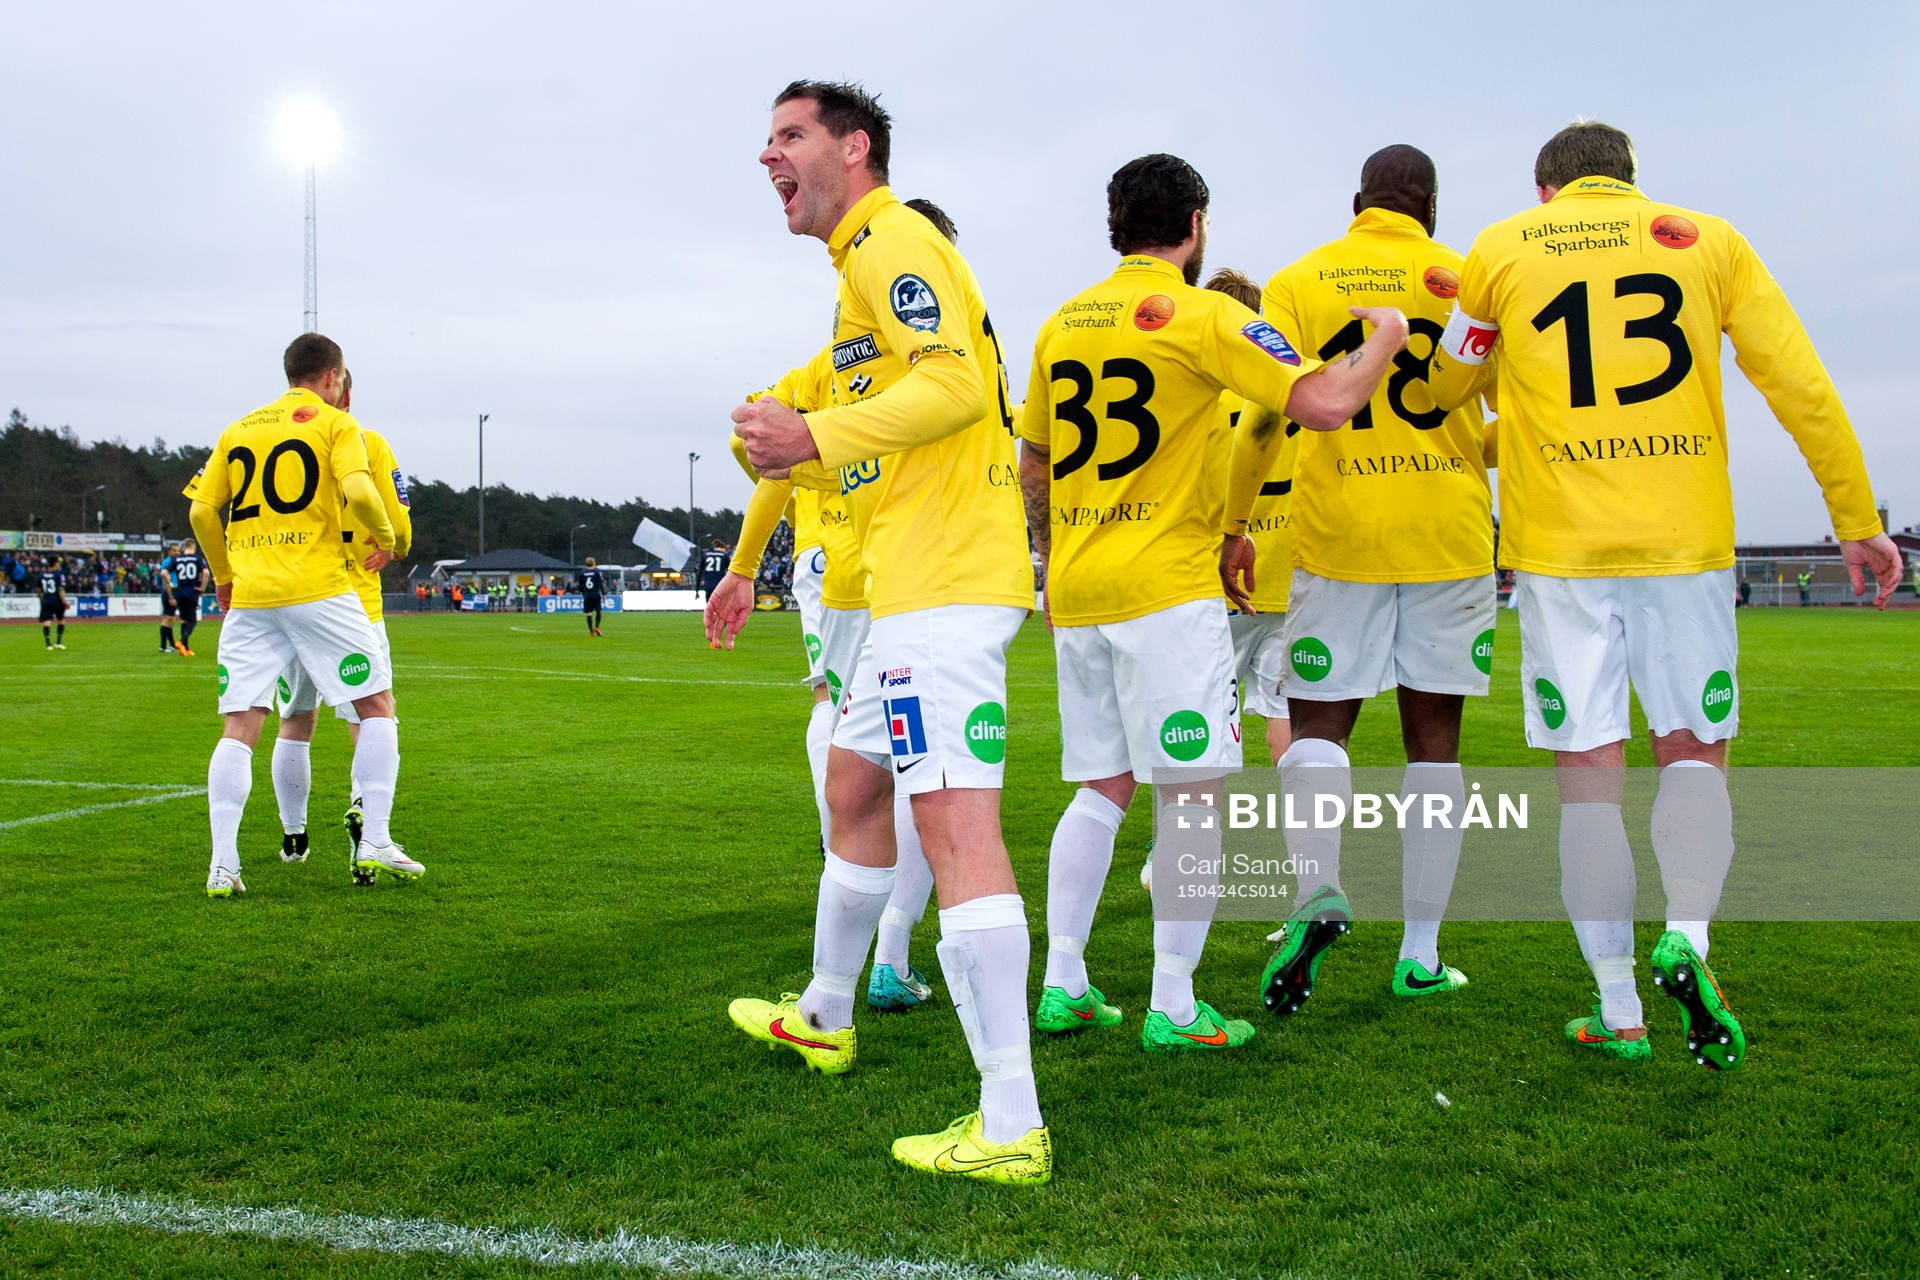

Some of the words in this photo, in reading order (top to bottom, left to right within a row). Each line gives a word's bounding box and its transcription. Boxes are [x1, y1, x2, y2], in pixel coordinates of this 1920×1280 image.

[1522, 220, 1630, 241] Falkenbergs
[1544, 234, 1630, 256] Sparbank
[1319, 266, 1406, 280] Falkenbergs
[1336, 280, 1406, 296] Sparbank
[1058, 300, 1125, 316] Falkenbergs
[1062, 315, 1118, 333] Sparbank
[1531, 273, 1693, 409] 13
[1051, 358, 1160, 481] 33
[1336, 453, 1465, 477] CAMPADRE
[227, 439, 320, 523] 20
[176, 563, 197, 579] 20
[705, 556, 722, 572] 21
[41, 580, 56, 593] 13
[586, 577, 594, 589] 6
[1293, 650, 1328, 666] dina
[341, 661, 369, 677] dina
[888, 668, 911, 678] INTER
[888, 677, 912, 687] SPORT
[1706, 688, 1731, 706] dina
[969, 720, 1006, 740] dina
[1164, 726, 1206, 744] dina
